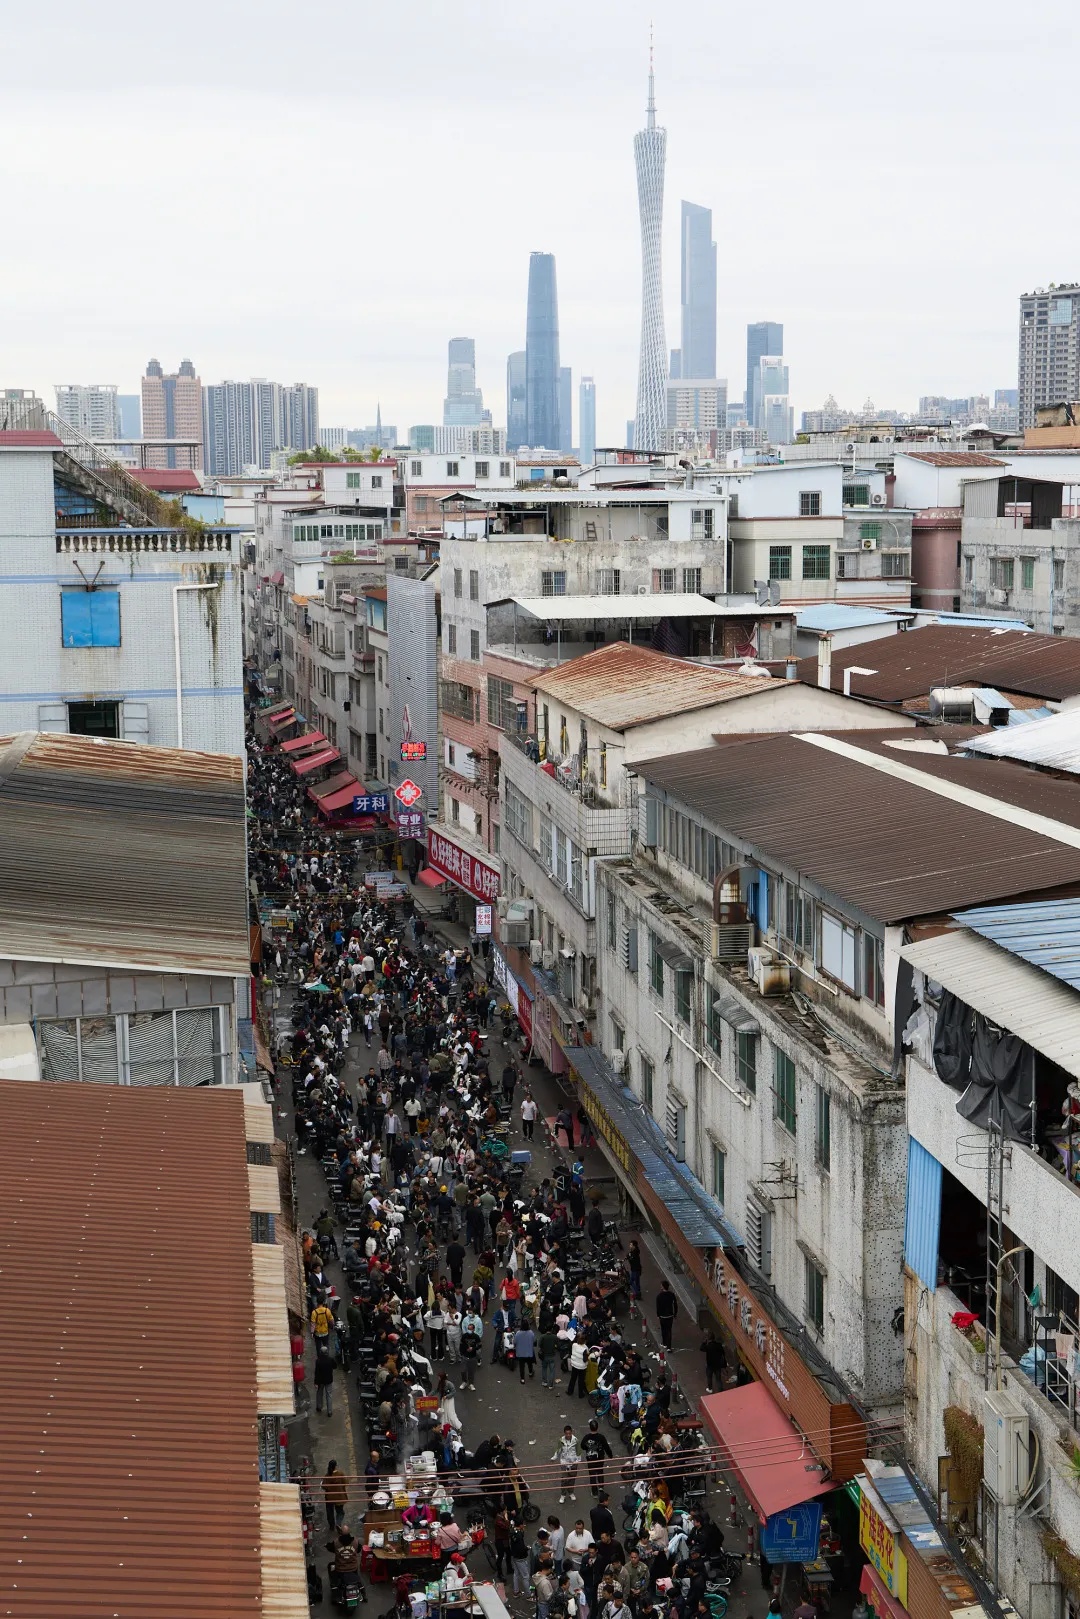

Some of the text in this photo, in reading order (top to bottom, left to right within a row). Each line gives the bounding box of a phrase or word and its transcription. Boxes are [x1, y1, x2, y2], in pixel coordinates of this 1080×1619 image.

[356, 796, 386, 811] 牙科
[398, 814, 421, 825] 专业
[438, 838, 460, 876] 好想来
